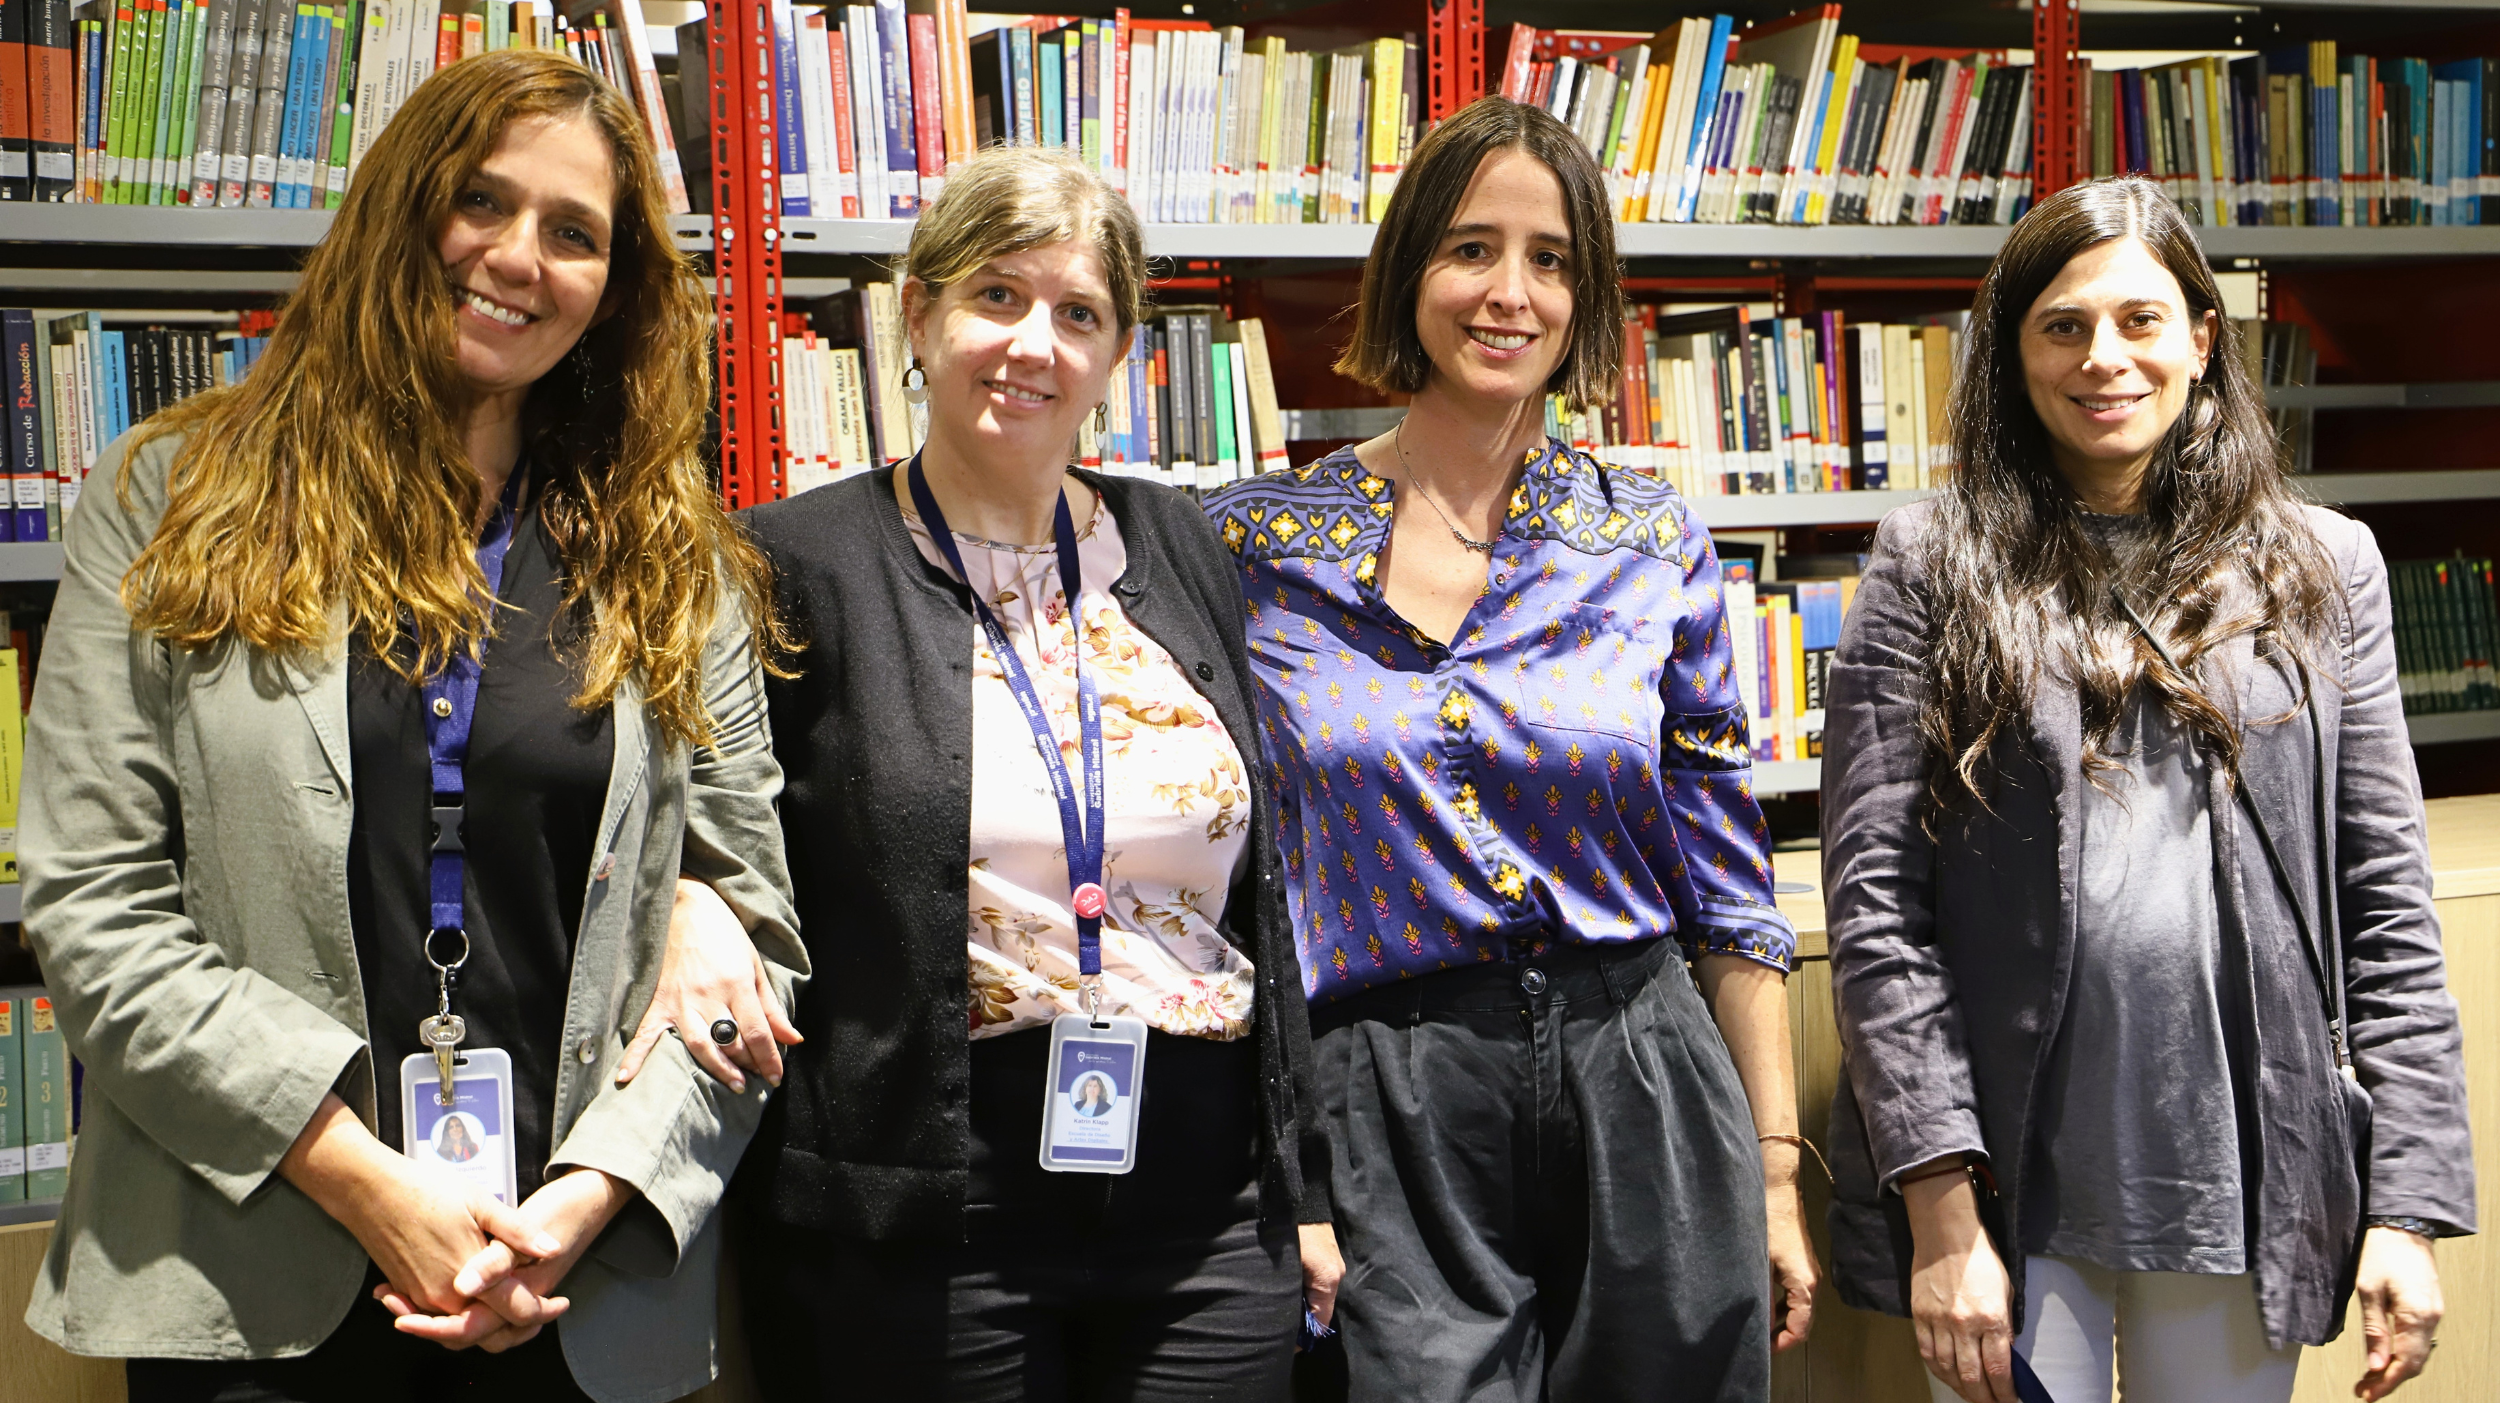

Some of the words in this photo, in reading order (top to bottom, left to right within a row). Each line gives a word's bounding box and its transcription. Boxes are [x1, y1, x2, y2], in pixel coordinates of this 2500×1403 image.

[885, 52, 893, 62] Un
[1089, 41, 1098, 97] Usabilidad
[1116, 50, 1129, 72] Maya
[213, 72, 223, 86] de
[242, 72, 252, 86] de
[271, 74, 281, 88] de
[385, 61, 395, 104] DOCTORALES
[412, 61, 422, 90] TORALES
[833, 48, 845, 99] PARISER
[886, 64, 895, 96] enfoque
[1067, 60, 1080, 98] GUION
[1116, 74, 1129, 103] Secrets
[42, 55, 52, 125] investigación
[212, 87, 220, 98] la
[240, 87, 248, 98] la
[270, 88, 280, 99] la
[290, 110, 299, 139] HACER
[297, 57, 305, 85] TESIS?
[308, 112, 317, 140] HACER
[314, 58, 323, 86] TESIS?
[360, 84, 371, 129] DOCTORALES
[888, 98, 898, 129] práctico
[1117, 105, 1127, 113] of
[1117, 114, 1128, 127] the
[42, 128, 50, 138] la
[206, 99, 219, 153] investigaci
[234, 100, 246, 157] investigació
[263, 101, 276, 158] investigació
[1068, 100, 1080, 148] MULTIM
[1117, 128, 1128, 146] Pros
[358, 133, 366, 151] TESIS
[789, 132, 798, 171] SISTEMAS
[171, 336, 183, 378] periodismo
[185, 336, 197, 378] periodismo
[200, 336, 213, 378] periodismo
[847, 355, 856, 388] historia
[17, 342, 36, 410] Redacción
[54, 372, 62, 387] Los
[65, 372, 73, 387] Los
[173, 379, 181, 387] el
[187, 378, 196, 386] el
[836, 355, 844, 392] FALLACI
[55, 388, 64, 429] elementos
[67, 388, 76, 429] elementos
[850, 389, 857, 398] la
[23, 415, 33, 429] de
[838, 396, 849, 435] ORIANA
[23, 433, 35, 468] Curso
[58, 430, 65, 440] de
[70, 430, 77, 440] de
[854, 419, 864, 463] Entrevista
[985, 622, 1003, 653] Gabriela
[998, 650, 1015, 679] Mistral
[1020, 690, 1038, 717] ugm.cl
[1087, 694, 1095, 722] ugm.cl
[1038, 733, 1057, 769] Gabriela
[1052, 769, 1068, 799] Mistral
[1092, 738, 1100, 770] Mistral
[1094, 771, 1102, 809] Gabriela
[40, 1051, 49, 1077] FREUD
[41, 1082, 51, 1104] 3
